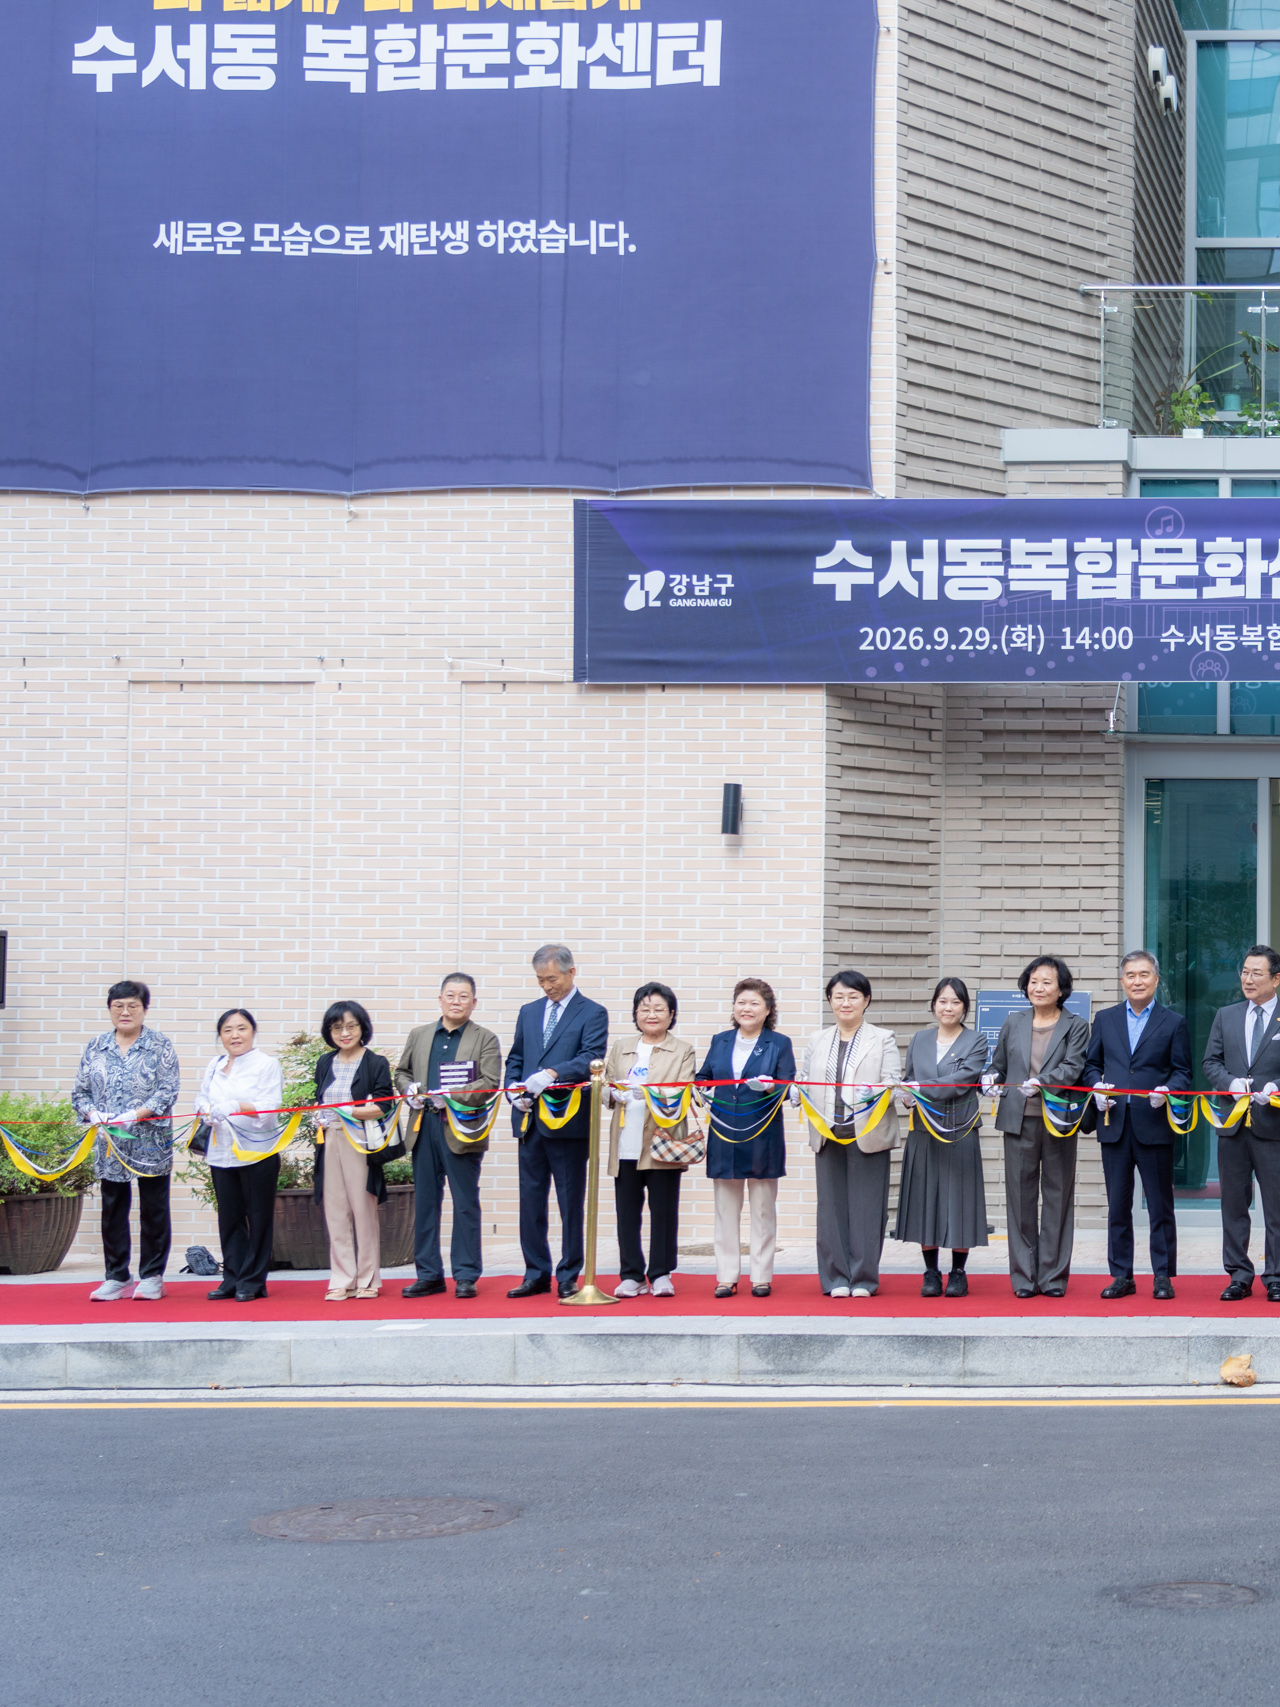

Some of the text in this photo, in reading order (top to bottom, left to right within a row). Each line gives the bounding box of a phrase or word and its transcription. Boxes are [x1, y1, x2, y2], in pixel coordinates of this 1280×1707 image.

[71, 19, 723, 94] 수서동 복합문화센터
[152, 219, 637, 256] 새로운 모습으로 재탄생 하였습니다.
[669, 573, 735, 596] 강남구
[718, 598, 732, 607] GU
[859, 624, 1045, 656] 2026.9.29.(화)
[1061, 626, 1134, 650] 14:00
